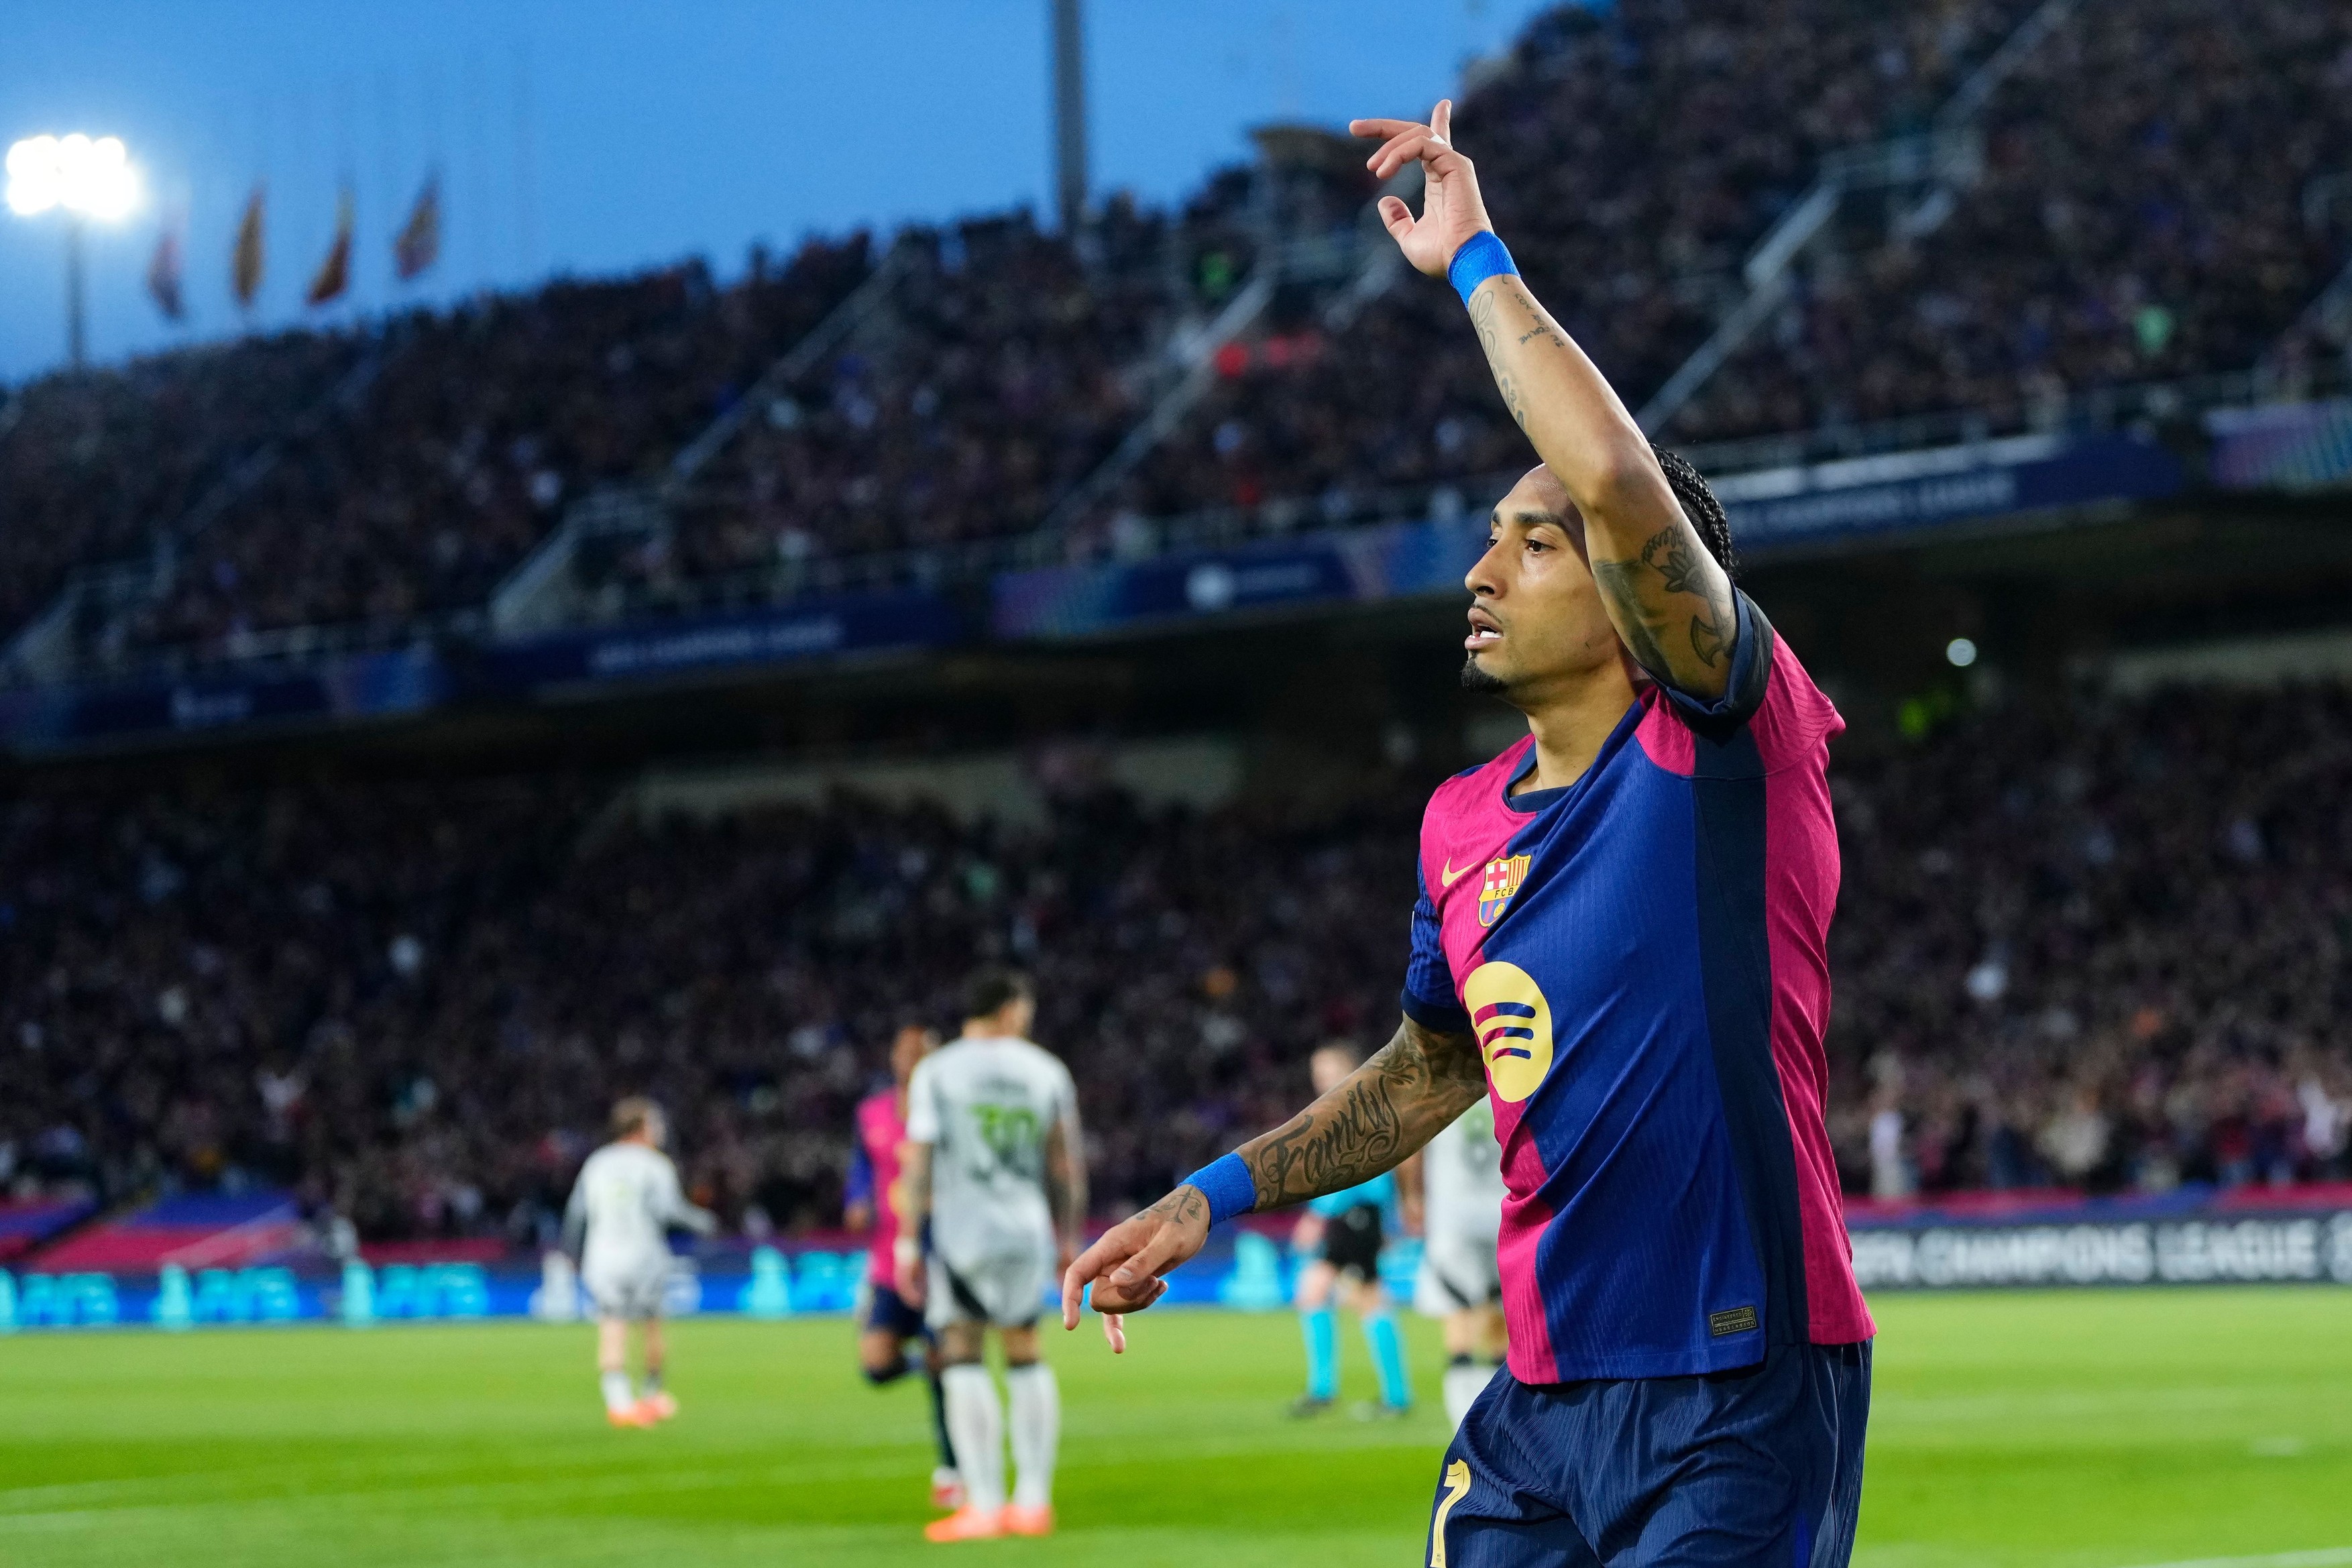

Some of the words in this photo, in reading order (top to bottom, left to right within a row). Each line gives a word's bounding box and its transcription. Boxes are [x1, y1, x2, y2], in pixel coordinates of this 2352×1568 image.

[1495, 887, 1514, 898] FCB
[1259, 1074, 1400, 1196] Family
[2156, 1219, 2318, 1282] LEAGUE
[1430, 1459, 1471, 1567] 7
